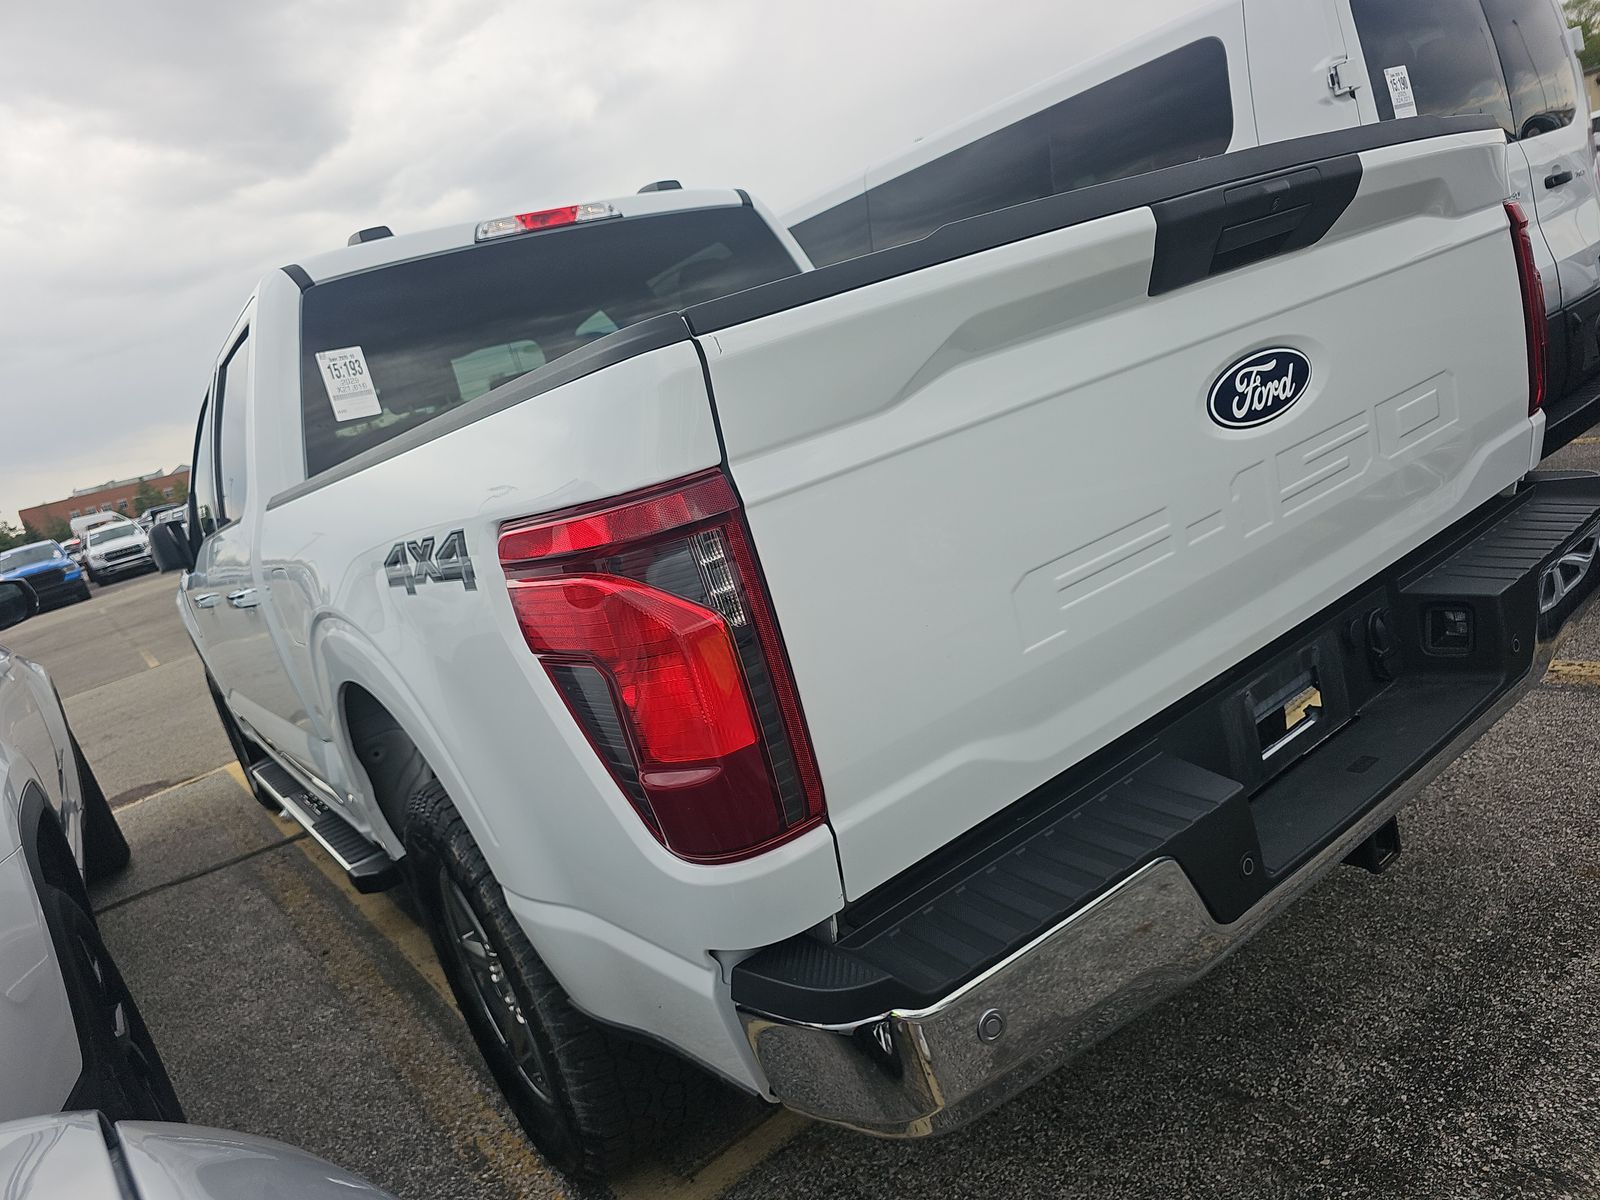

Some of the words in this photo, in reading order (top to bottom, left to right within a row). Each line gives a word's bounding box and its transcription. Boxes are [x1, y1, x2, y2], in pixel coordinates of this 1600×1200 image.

[327, 359, 364, 380] 15:193
[1232, 359, 1296, 419] Ford
[1010, 368, 1459, 655] F-150
